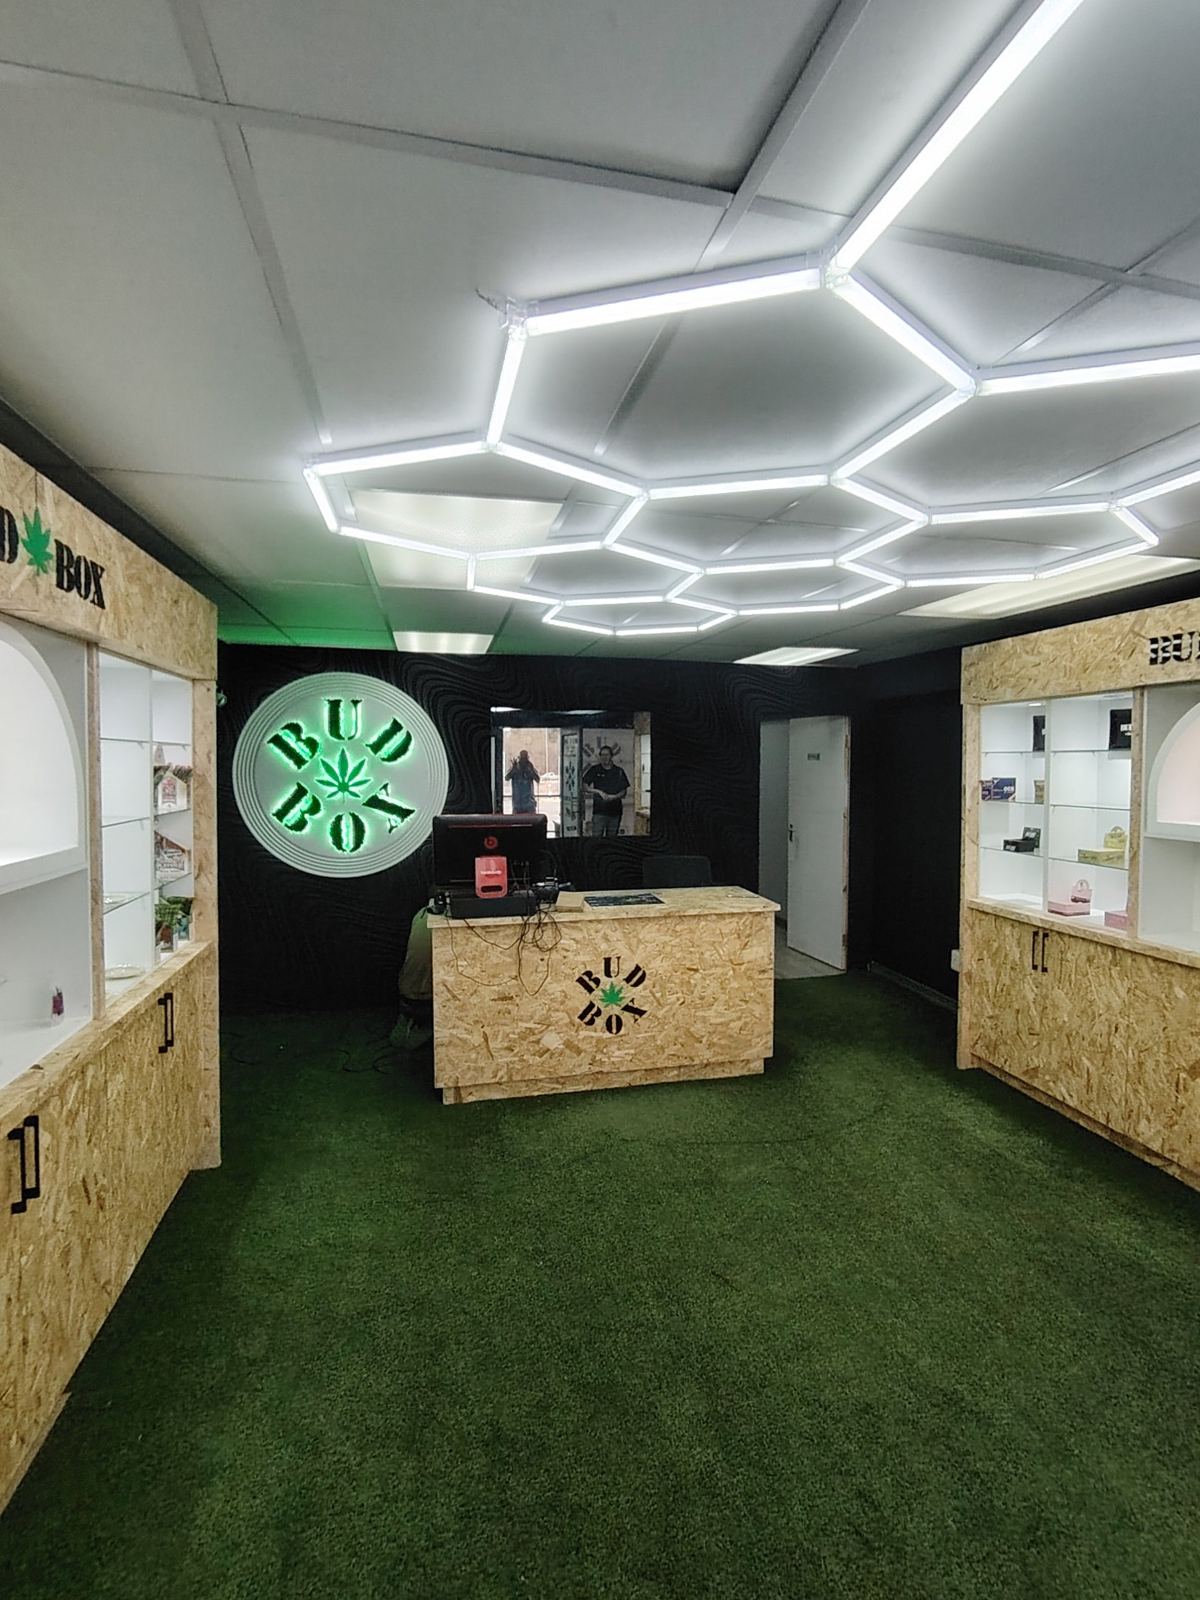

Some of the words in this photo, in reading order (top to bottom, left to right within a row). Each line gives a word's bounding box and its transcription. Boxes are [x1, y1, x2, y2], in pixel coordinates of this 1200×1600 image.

[54, 538, 106, 610] BOX
[1149, 631, 1200, 665] BU
[267, 698, 413, 770] BUD
[272, 782, 416, 853] BOX
[575, 955, 647, 994] BUD
[577, 997, 648, 1035] BOX
